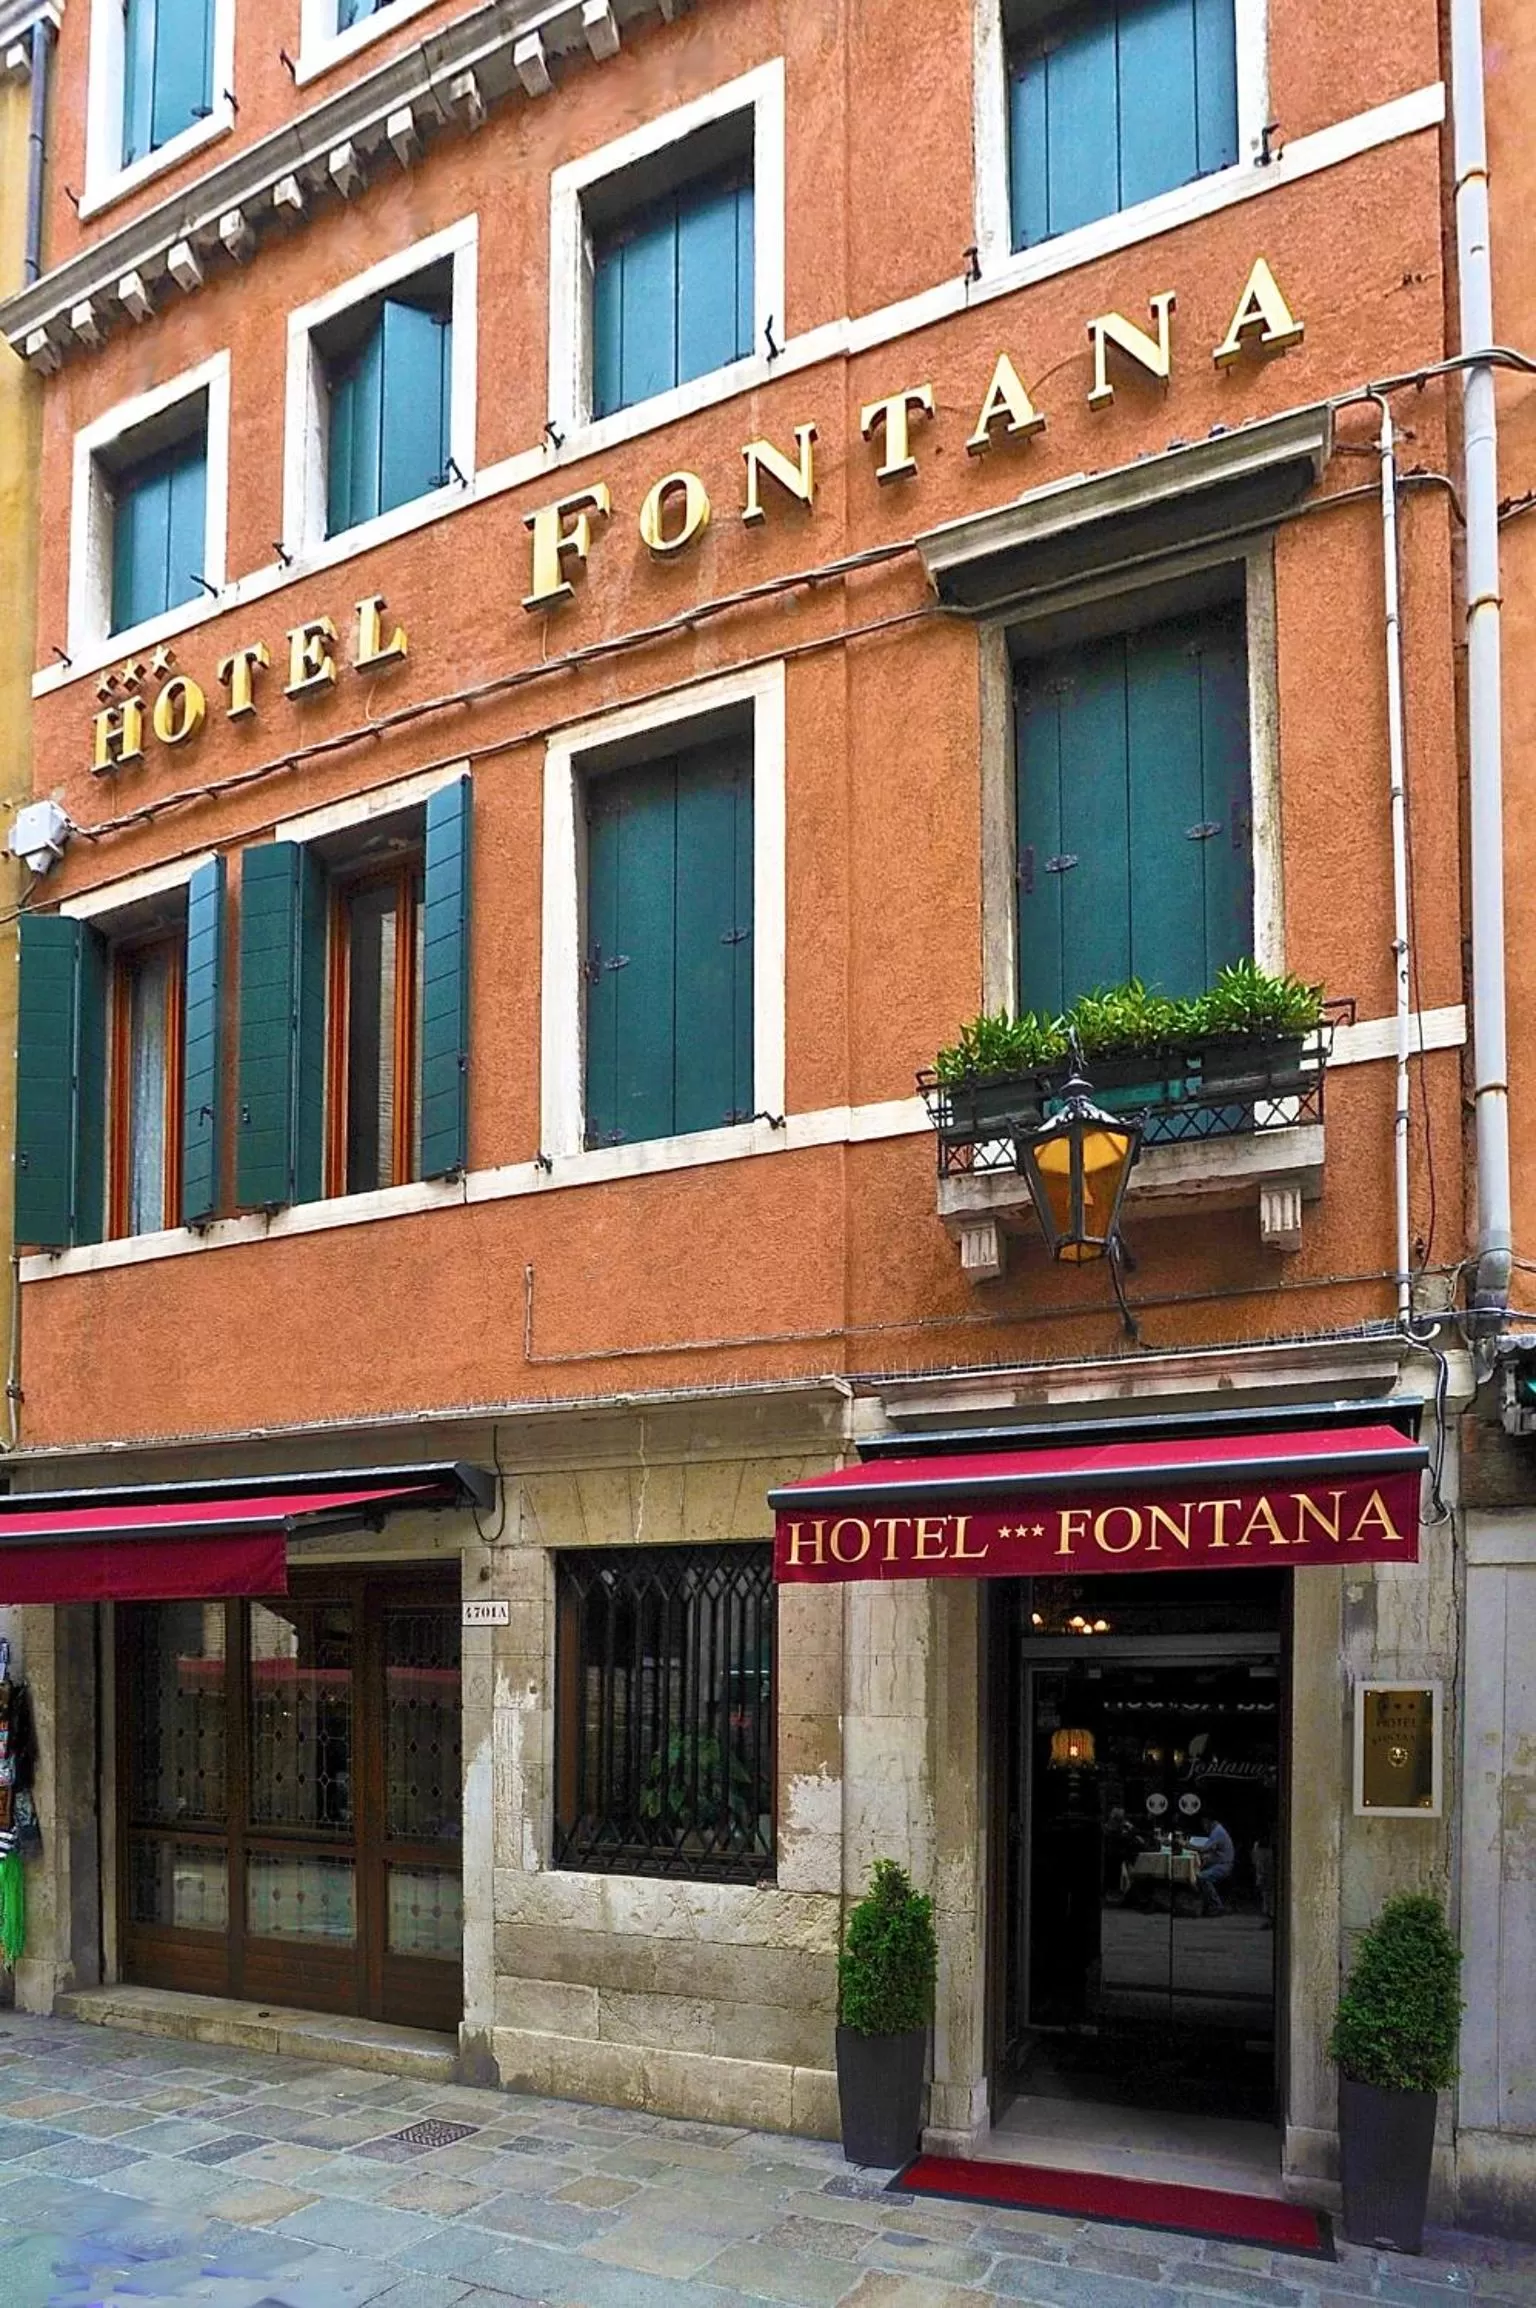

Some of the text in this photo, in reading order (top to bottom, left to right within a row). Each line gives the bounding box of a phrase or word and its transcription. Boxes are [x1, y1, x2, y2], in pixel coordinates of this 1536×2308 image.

[90, 258, 1304, 777] HOTEL FONTANA
[785, 1488, 1404, 1566] HOTEL FONTANA
